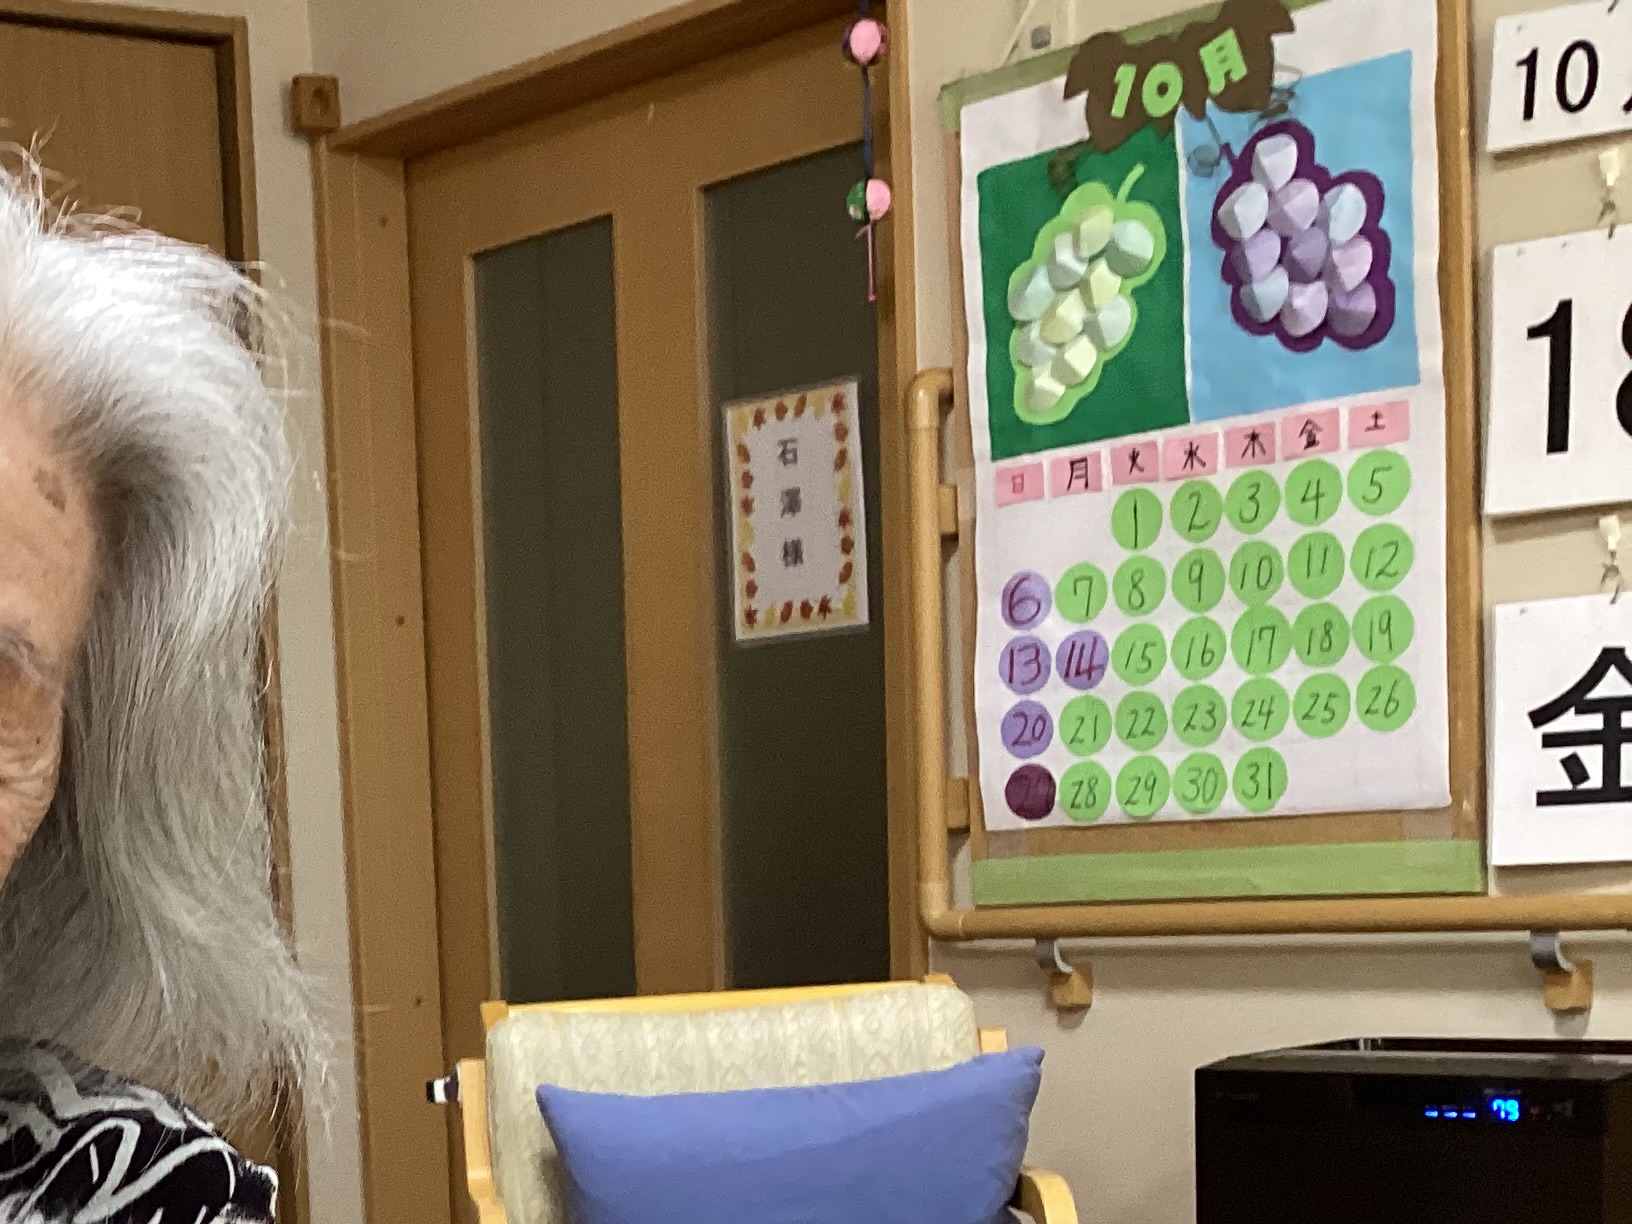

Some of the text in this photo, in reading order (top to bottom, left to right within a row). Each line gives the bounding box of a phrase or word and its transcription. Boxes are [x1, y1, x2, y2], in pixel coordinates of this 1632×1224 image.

[1109, 27, 1248, 119] 10月
[1515, 39, 1632, 122] 10
[1010, 411, 1386, 495] 日 月 火 水 木 金 土
[1186, 493, 1209, 531] 2
[1238, 482, 1261, 523] 3
[1301, 478, 1325, 520] 4
[1361, 466, 1392, 505] 5
[1008, 541, 1400, 626] 6 7 8 9 10 11 12
[1007, 610, 1393, 683] 13 14 15 16 17 18 19
[1012, 680, 1400, 747] 20 21 22 23 24 25 26
[1527, 646, 1632, 807] 金
[1070, 778, 1098, 809] 28
[1123, 774, 1158, 807] 29
[1182, 769, 1218, 802] 30
[1241, 766, 1273, 802] 31
